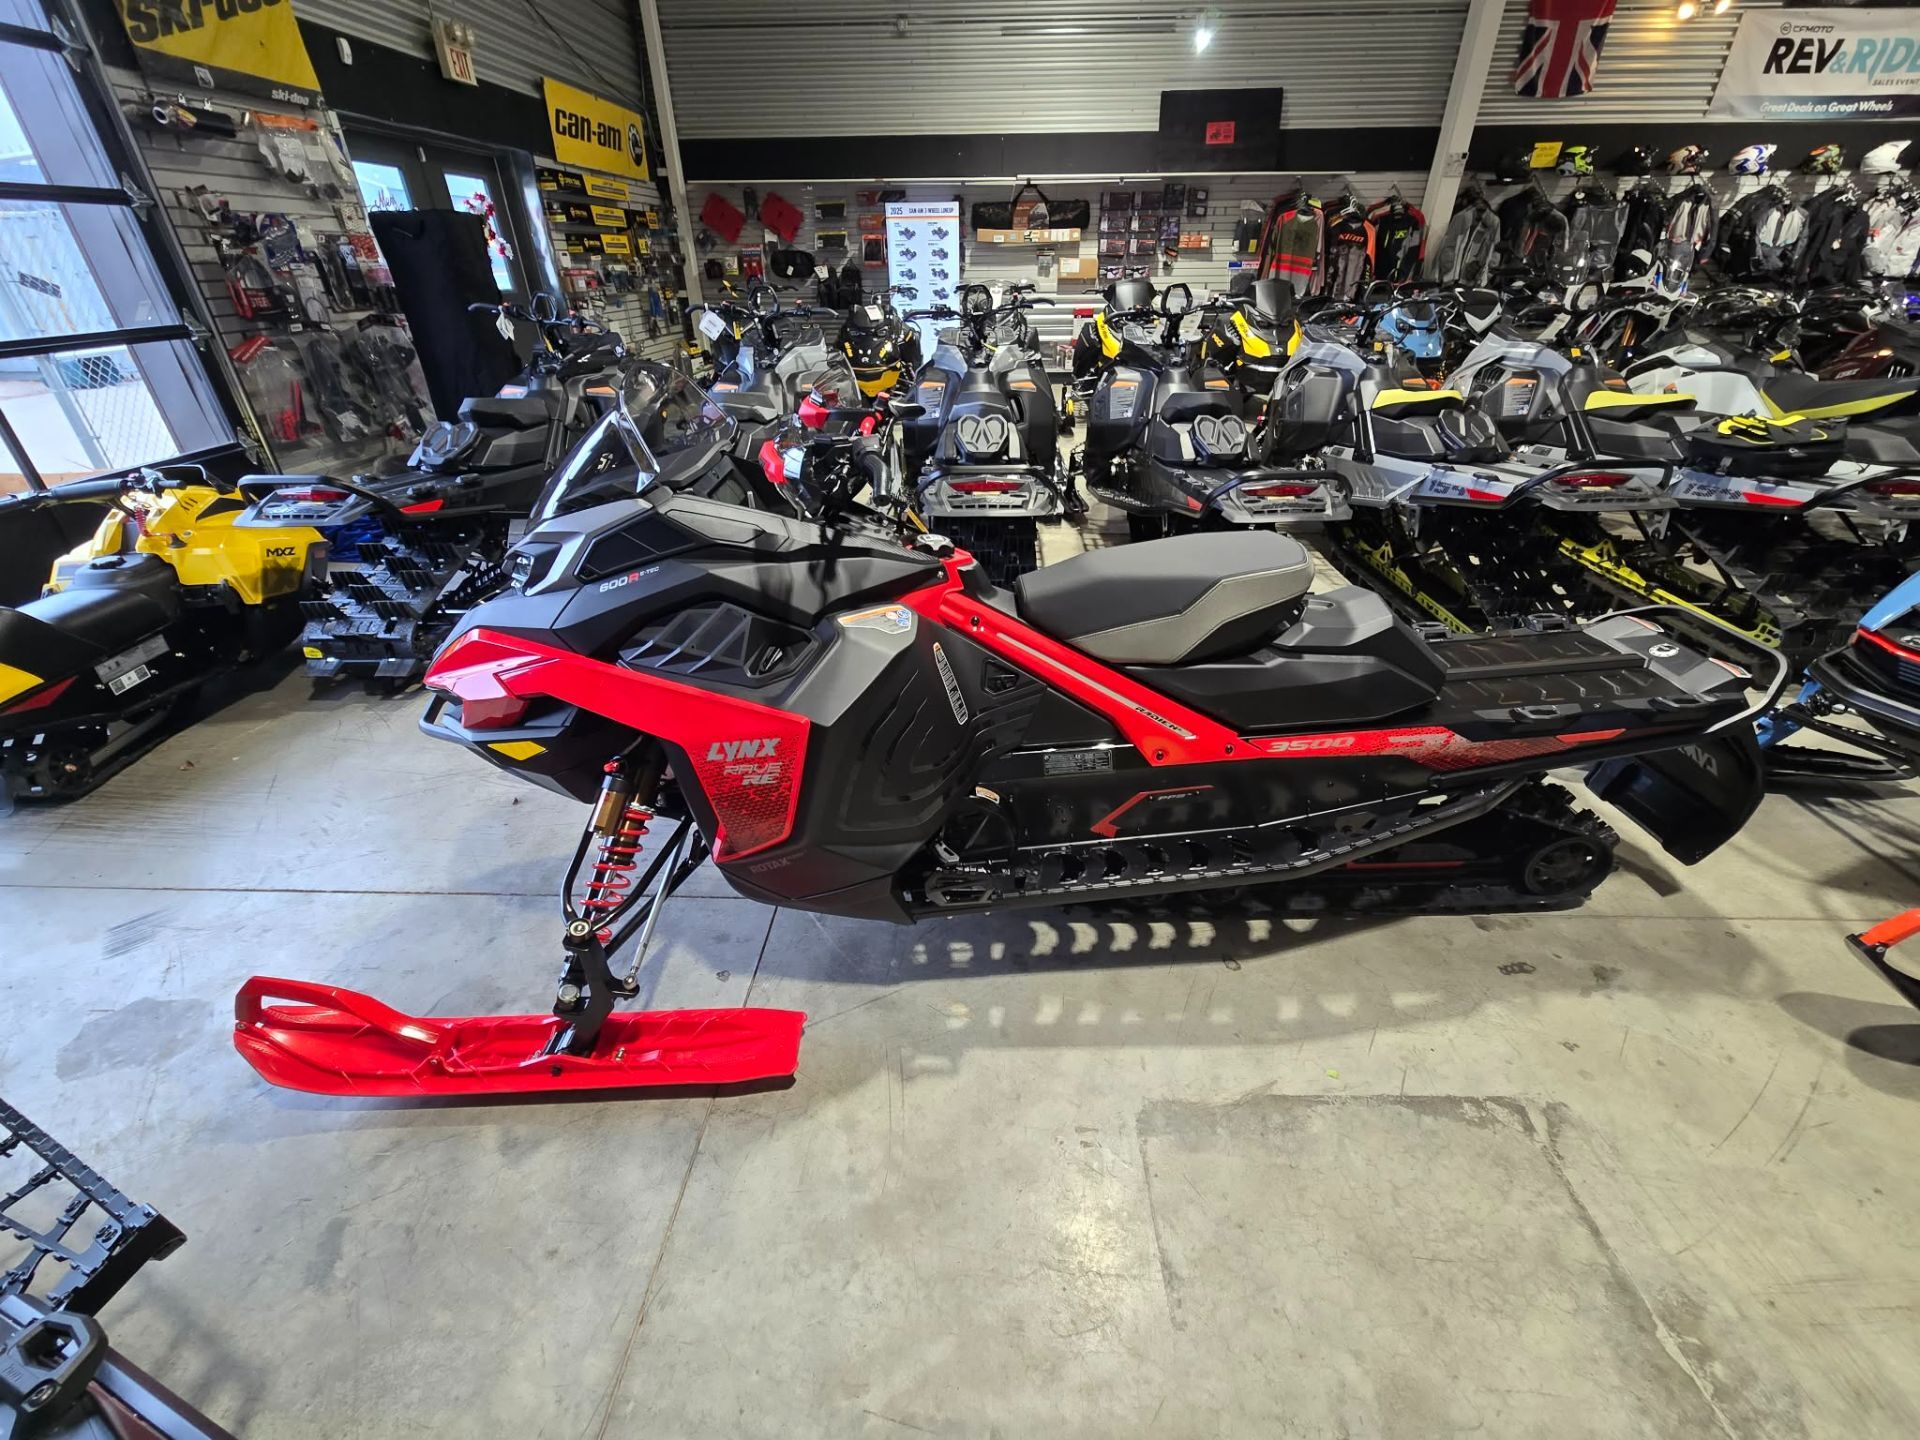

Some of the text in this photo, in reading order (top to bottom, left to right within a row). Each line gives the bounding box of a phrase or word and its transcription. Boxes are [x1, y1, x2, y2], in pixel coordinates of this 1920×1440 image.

[450, 48, 471, 80] EXIT
[1760, 102, 1787, 112] Great
[1787, 102, 1813, 112] Deals
[1828, 102, 1857, 112] Great
[1859, 100, 1893, 112] Wheels
[555, 108, 622, 152] can-am
[266, 546, 296, 557] MXZ
[706, 737, 781, 762] LYNX
[1266, 736, 1356, 752] 3500
[723, 762, 783, 777] RAVE
[741, 774, 780, 786] RE
